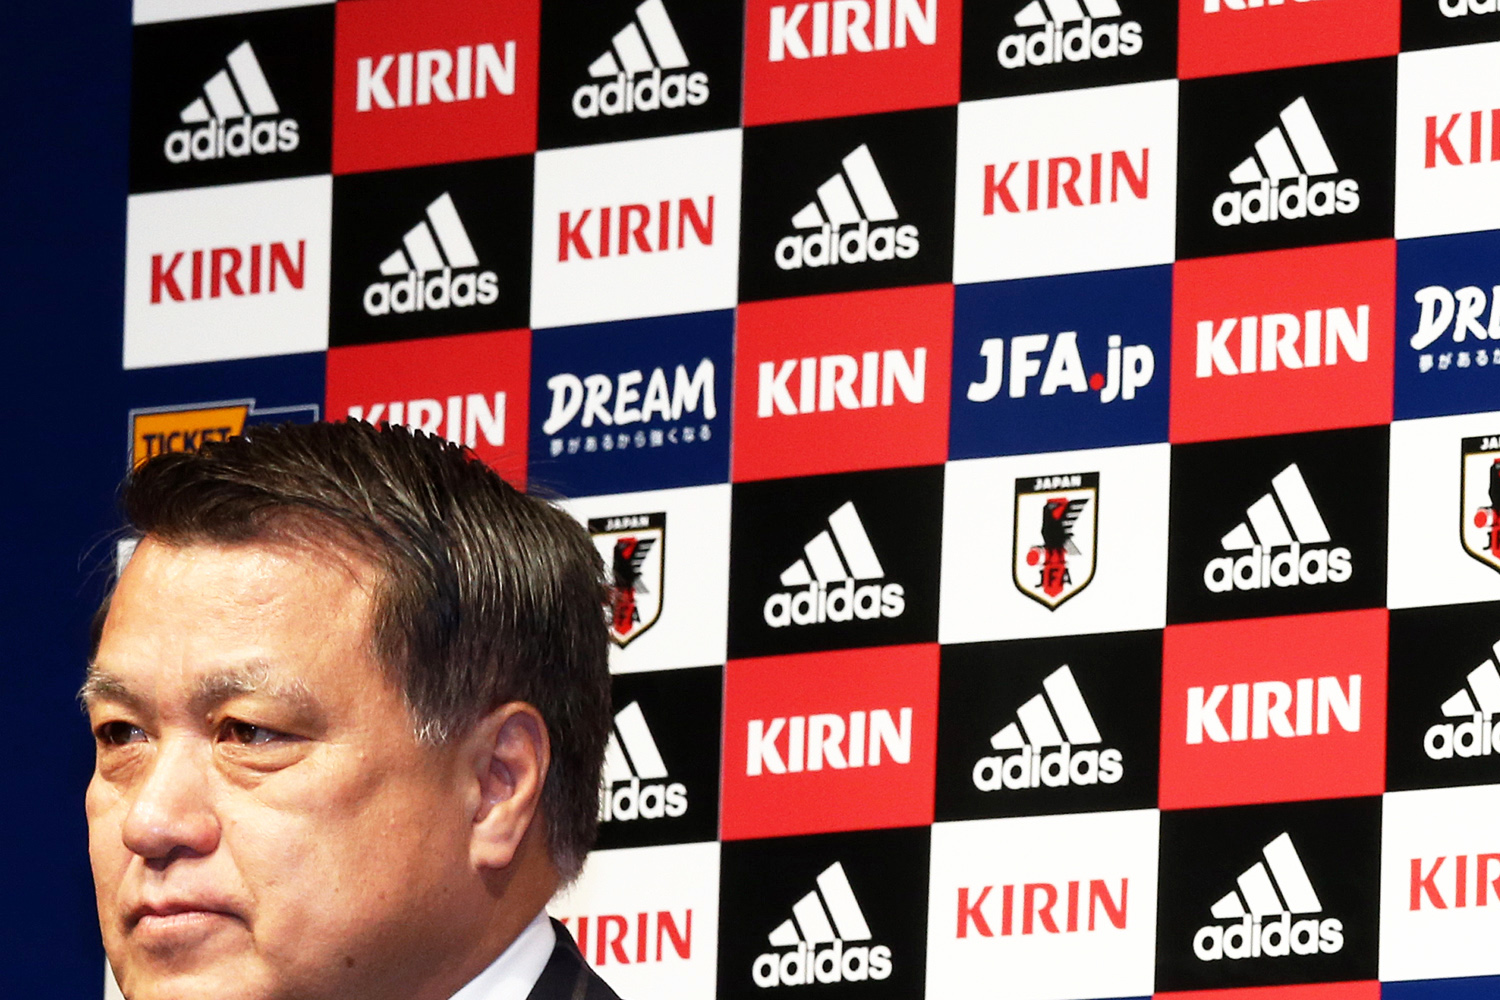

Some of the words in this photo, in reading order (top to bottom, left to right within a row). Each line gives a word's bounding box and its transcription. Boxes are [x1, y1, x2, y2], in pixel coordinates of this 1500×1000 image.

[769, 0, 936, 61] KIRIN
[998, 17, 1143, 69] adidas
[357, 42, 515, 111] KIRIN
[572, 68, 709, 119] adidas
[164, 117, 299, 163] adidas
[984, 149, 1148, 215] KIRIN
[1211, 174, 1360, 227] adidas
[559, 196, 714, 262] KIRIN
[775, 220, 919, 270] adidas
[150, 240, 305, 304] KIRIN
[364, 268, 499, 315] adidas
[967, 331, 1155, 403] JFA.jp
[1196, 305, 1369, 377] KIRIN
[542, 358, 716, 435] DREAM
[758, 348, 926, 417] KIRIN
[1034, 474, 1081, 491] JAPAN
[605, 515, 650, 531] JAPAN
[1034, 564, 1072, 589] JFA
[1203, 541, 1353, 594] adidas
[763, 579, 905, 628] adidas
[1186, 674, 1361, 744] KIRIN
[747, 708, 912, 776] KIRIN
[972, 743, 1124, 793] adidas
[598, 776, 688, 822] idas
[957, 879, 1127, 938] KIRIN
[1193, 909, 1344, 961] adidas
[560, 909, 692, 966] IRIN
[752, 938, 892, 989] adidas
